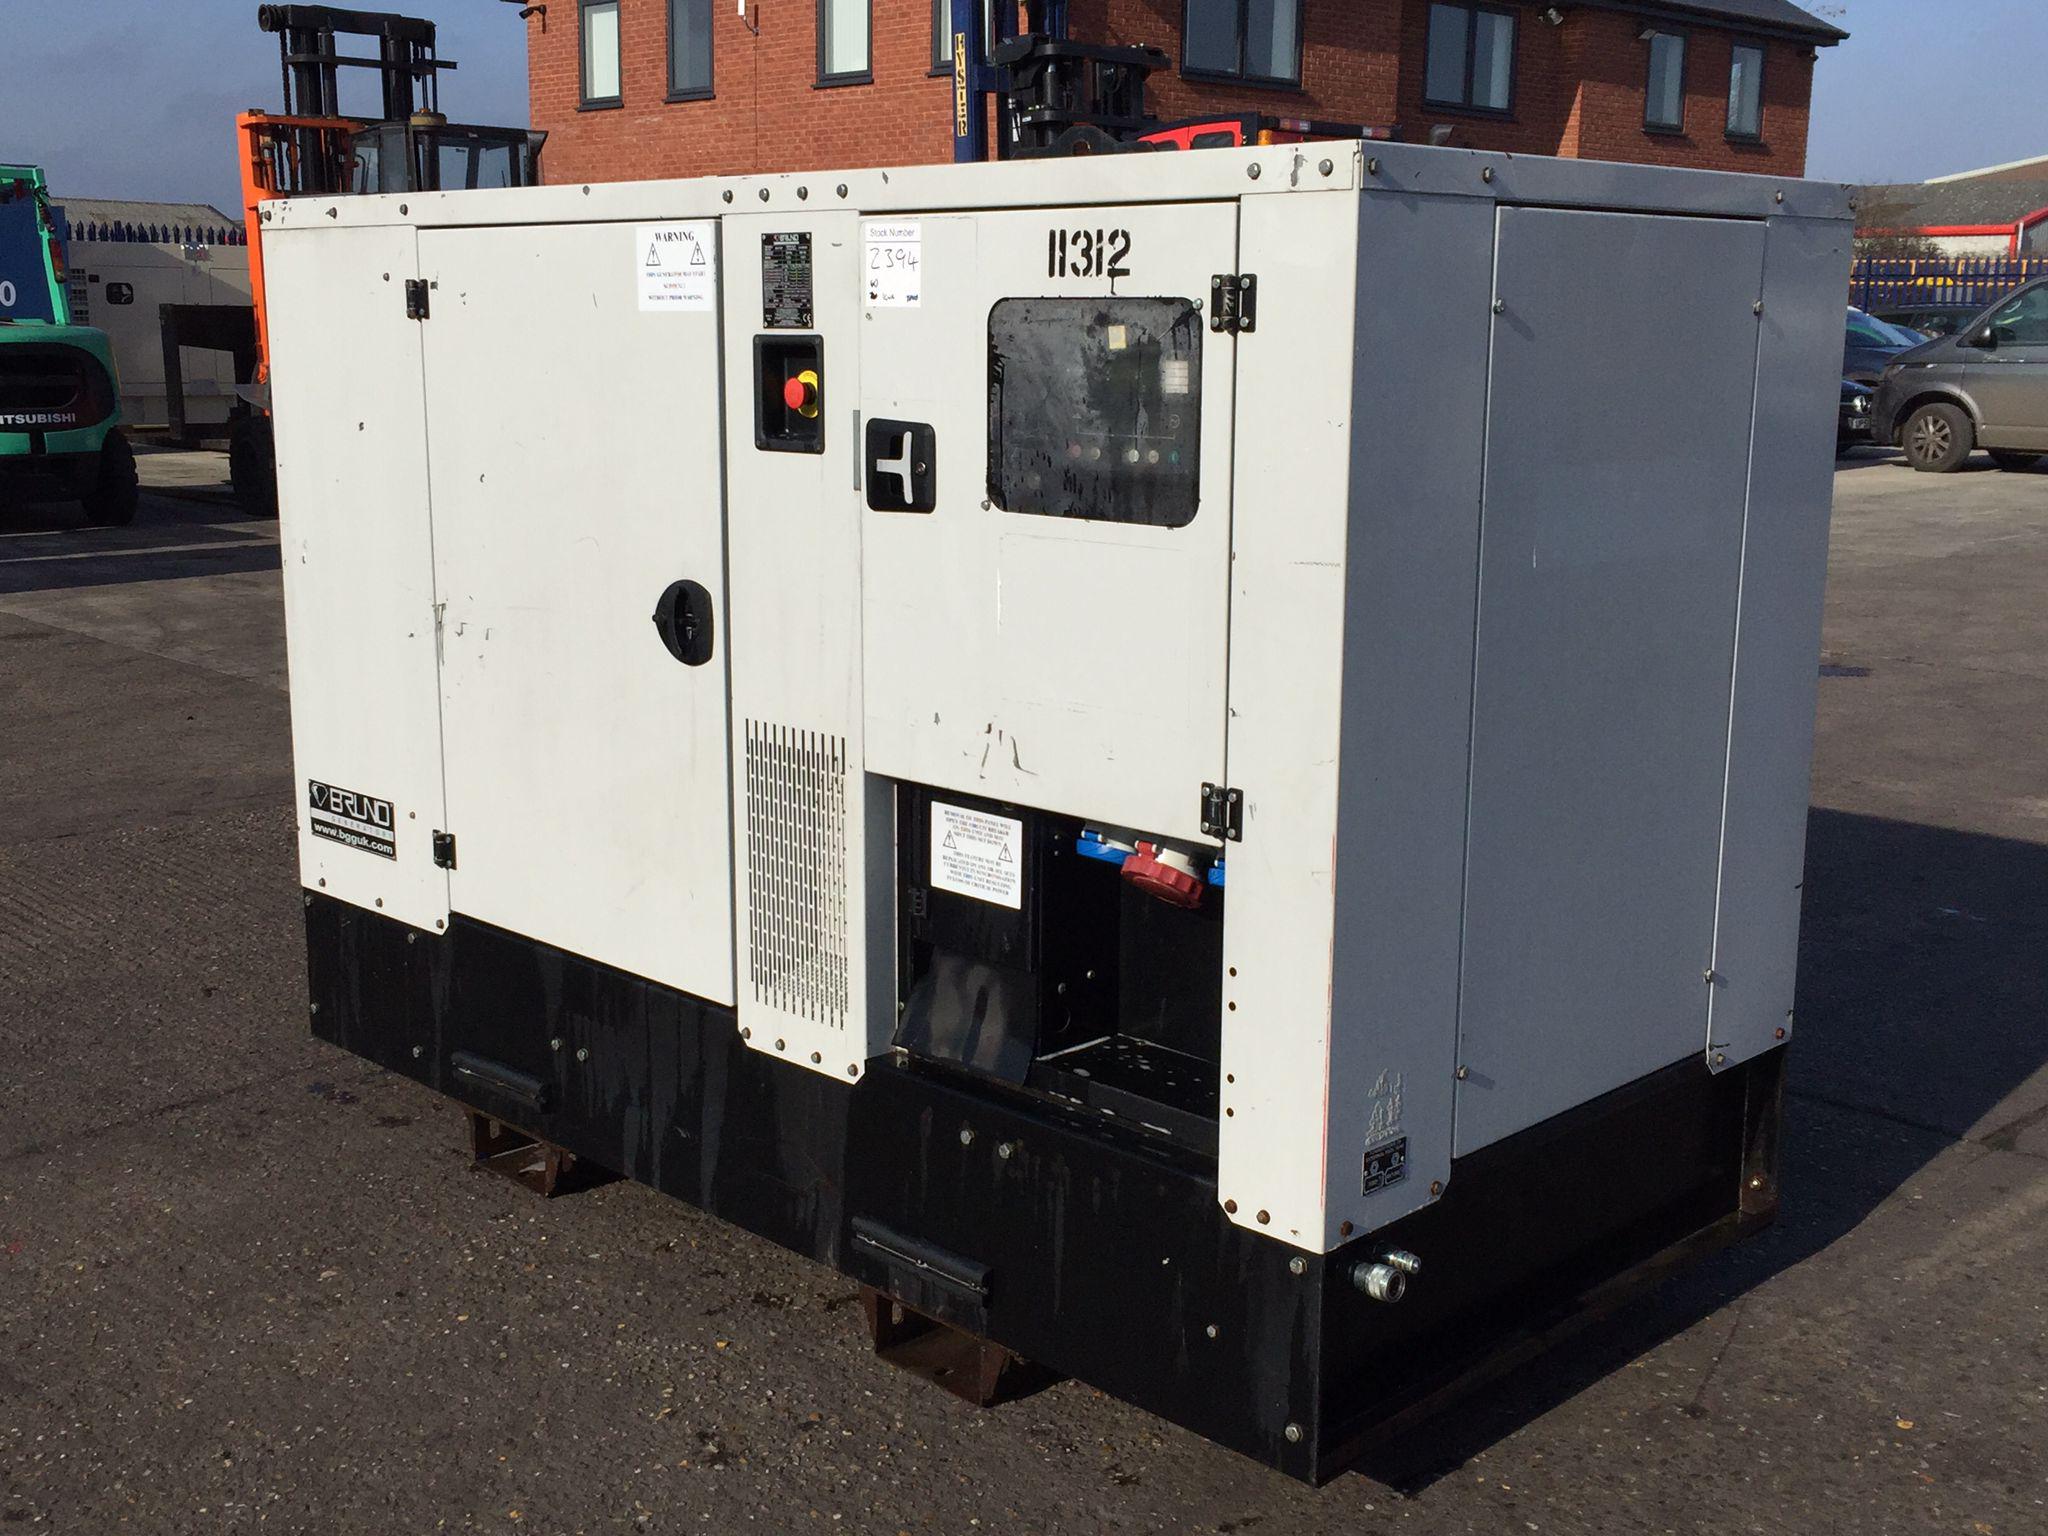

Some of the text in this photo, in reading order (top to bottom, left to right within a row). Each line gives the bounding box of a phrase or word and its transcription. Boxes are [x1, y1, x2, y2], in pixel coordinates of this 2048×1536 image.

[955, 34, 967, 136] HYSTER
[654, 231, 695, 242] WARNING
[870, 228, 915, 237] Stock Number
[870, 247, 919, 272] 2394
[1047, 228, 1131, 278] 11312
[0, 280, 16, 307] 0
[0, 412, 76, 425] ITSUBISHI
[329, 787, 390, 827] BRUNO
[313, 821, 393, 854] www.bgguk.com
